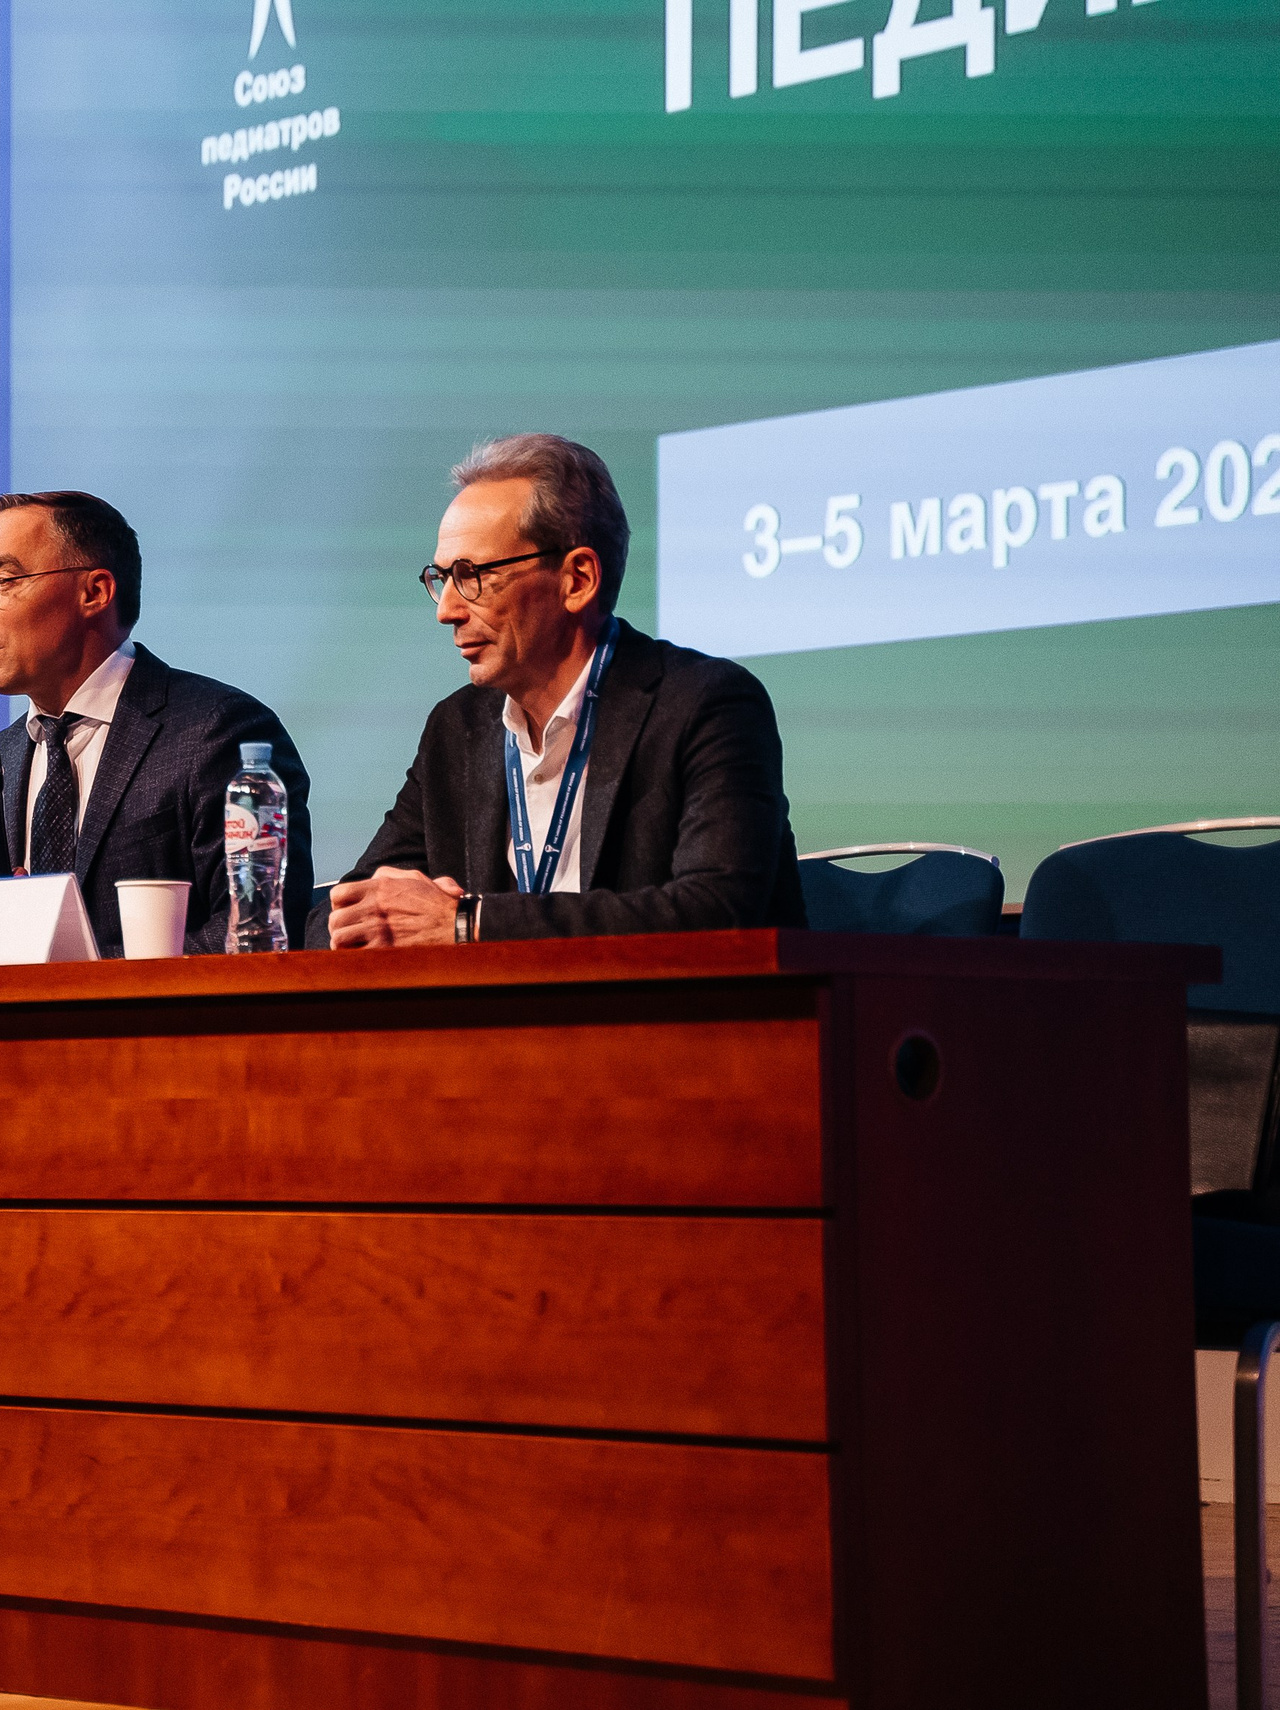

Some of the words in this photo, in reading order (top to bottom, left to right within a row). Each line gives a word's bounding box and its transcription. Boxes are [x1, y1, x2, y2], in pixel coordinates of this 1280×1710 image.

[233, 63, 306, 108] Союз
[200, 105, 341, 167] педиатров
[223, 162, 317, 211] России
[889, 474, 1126, 569] марта
